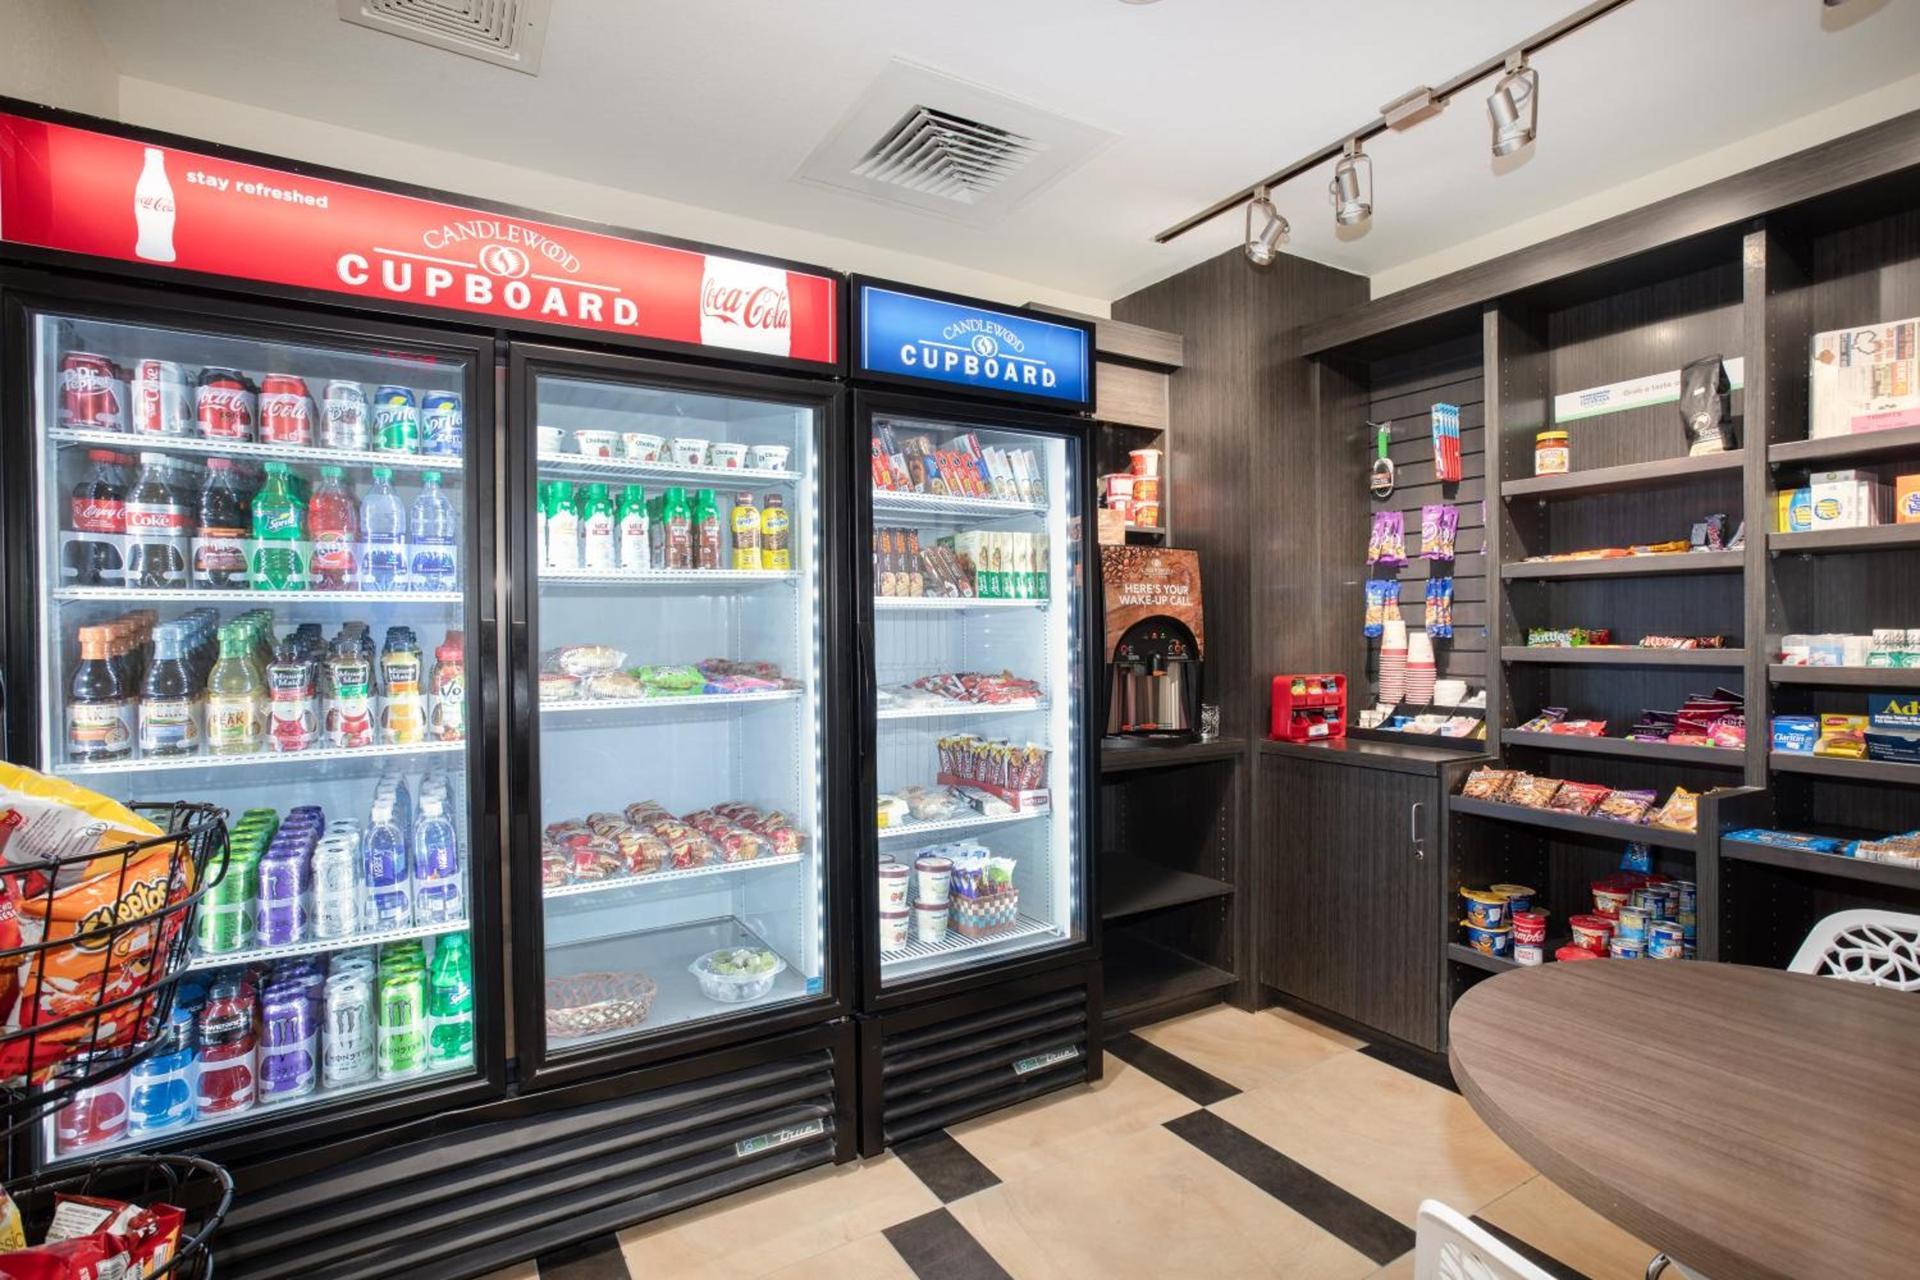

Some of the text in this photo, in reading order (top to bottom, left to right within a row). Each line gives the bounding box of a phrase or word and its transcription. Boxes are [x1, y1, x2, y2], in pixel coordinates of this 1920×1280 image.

[187, 171, 329, 209] stay refreshed
[423, 220, 581, 274] CANDLEWOOD
[337, 253, 638, 326] CUPBOARD
[702, 277, 788, 330] Coca-Cola
[943, 319, 1025, 353] CANDLEWOOD
[77, 366, 98, 378] Dr
[901, 345, 1056, 388] CUPBOARD
[131, 513, 170, 527] Coke
[268, 514, 295, 530] Sprite
[1124, 583, 1189, 595] HERE'S YOUR
[1119, 595, 1168, 605] WAKE-UP
[1528, 631, 1571, 646] Skittles
[1774, 733, 1804, 743] Claritin
